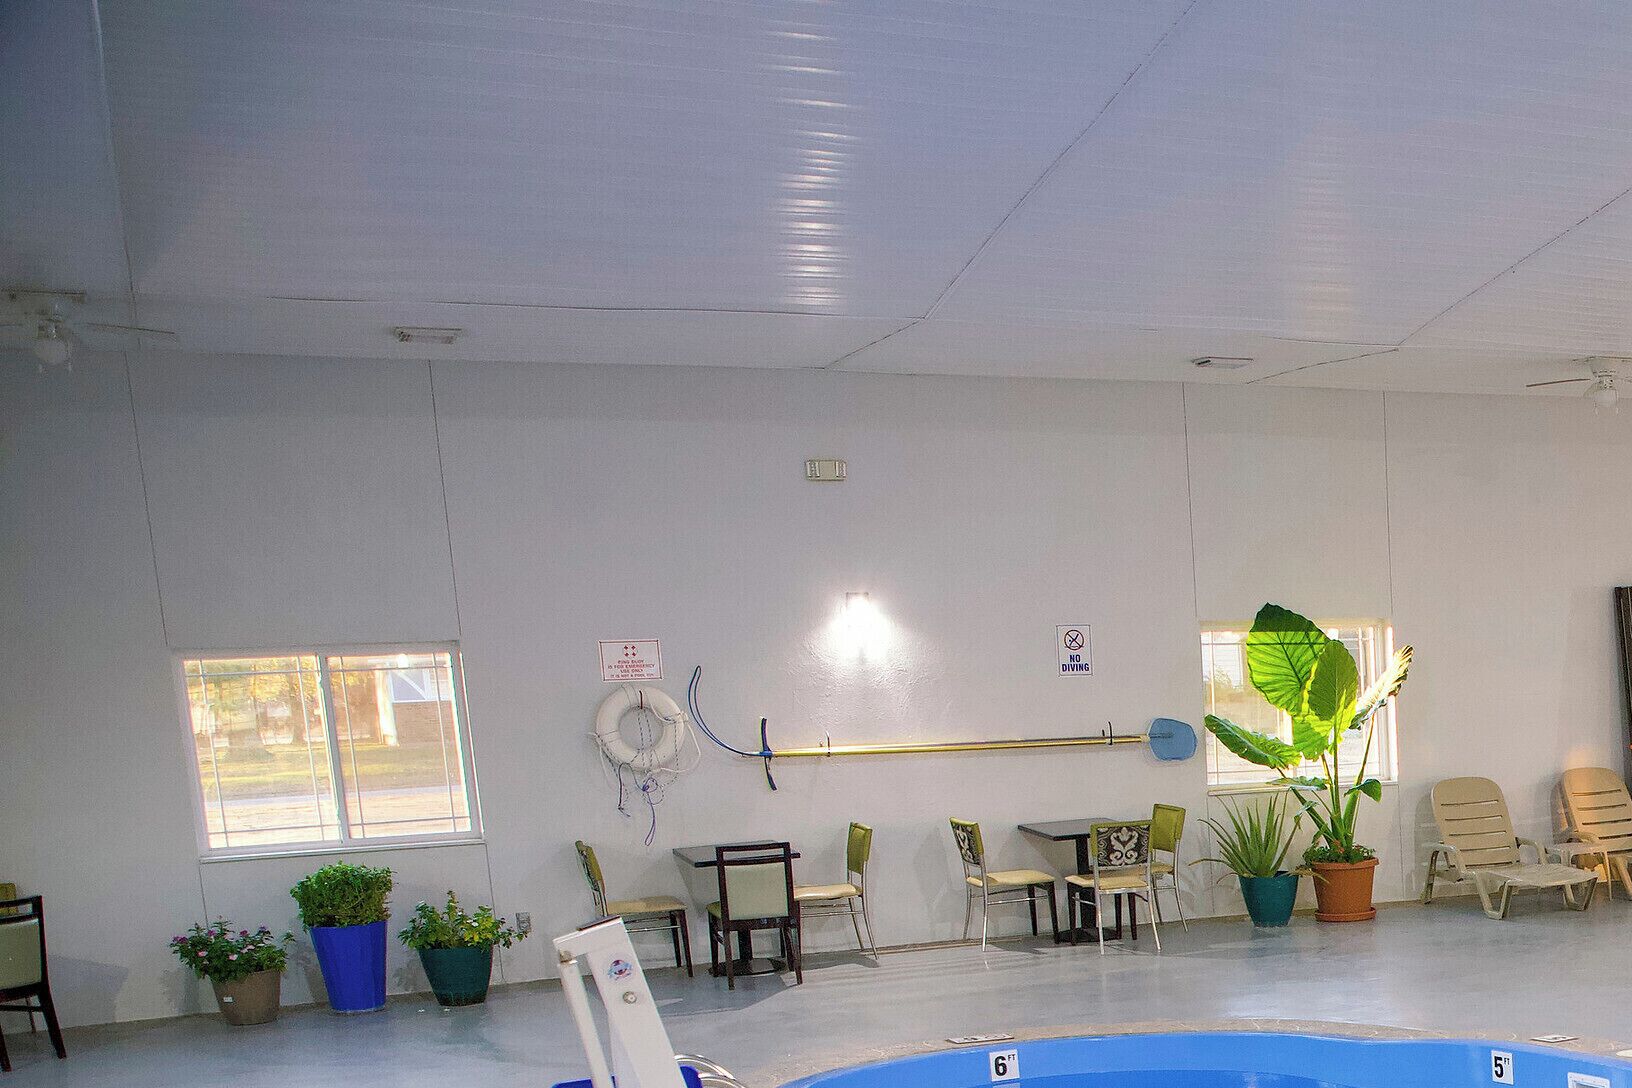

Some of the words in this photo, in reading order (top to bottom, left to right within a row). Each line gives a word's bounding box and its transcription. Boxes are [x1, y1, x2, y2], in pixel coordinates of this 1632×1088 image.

[1062, 663, 1089, 672] DIVING
[995, 1056, 1007, 1076] 6
[1494, 1056, 1504, 1078] 5
